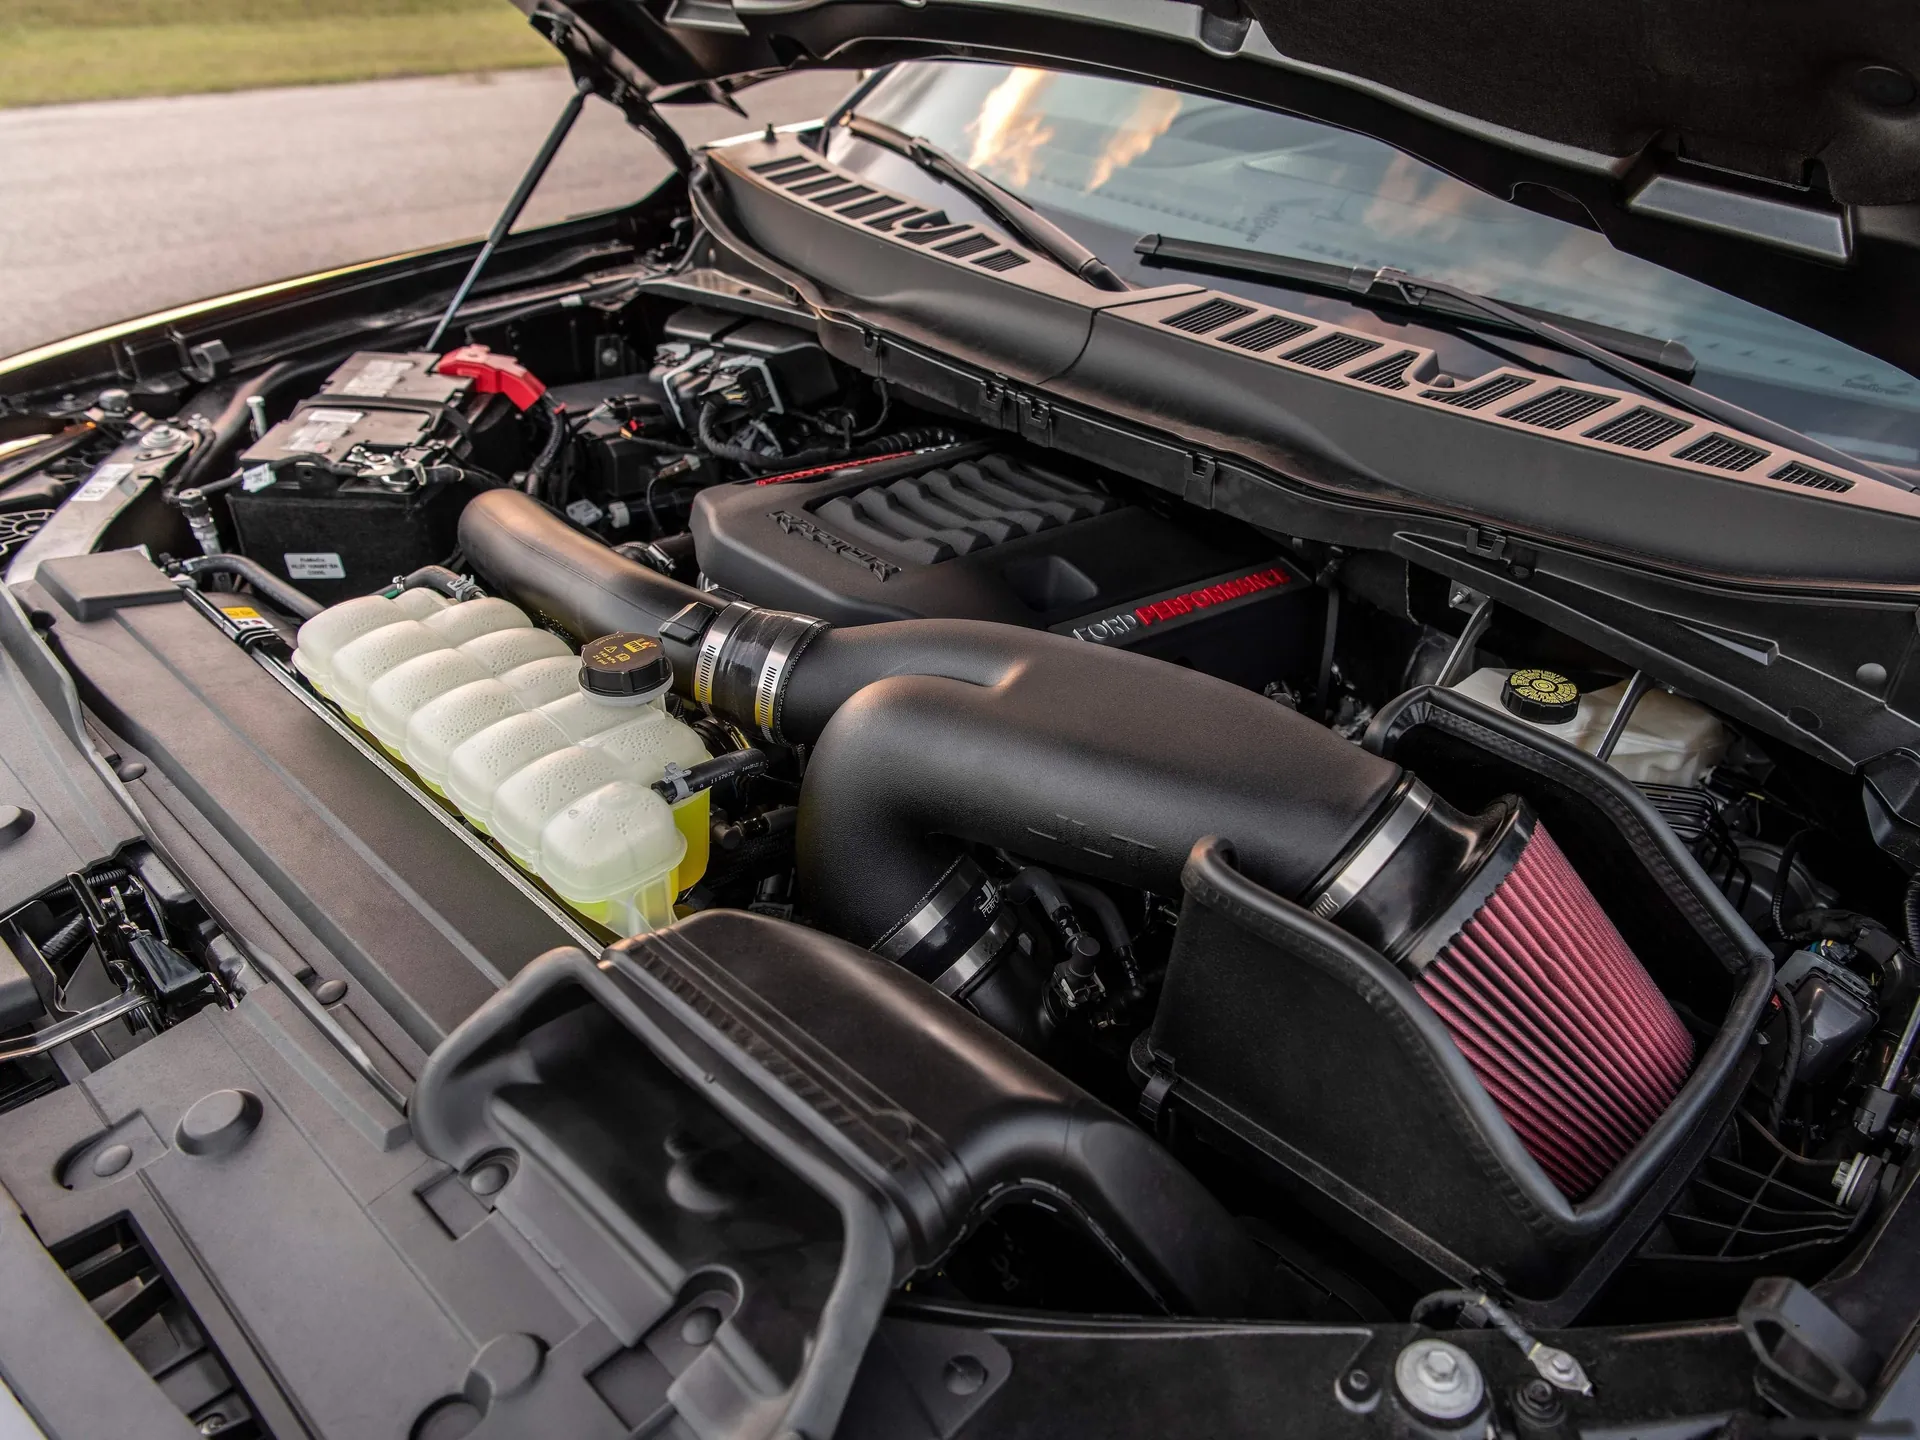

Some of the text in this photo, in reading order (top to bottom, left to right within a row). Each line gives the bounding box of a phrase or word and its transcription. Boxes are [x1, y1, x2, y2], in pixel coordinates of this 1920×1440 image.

[766, 510, 902, 582] RAPTOR
[1071, 567, 1291, 642] FORD PERFORMANCE
[979, 879, 997, 910] JL
